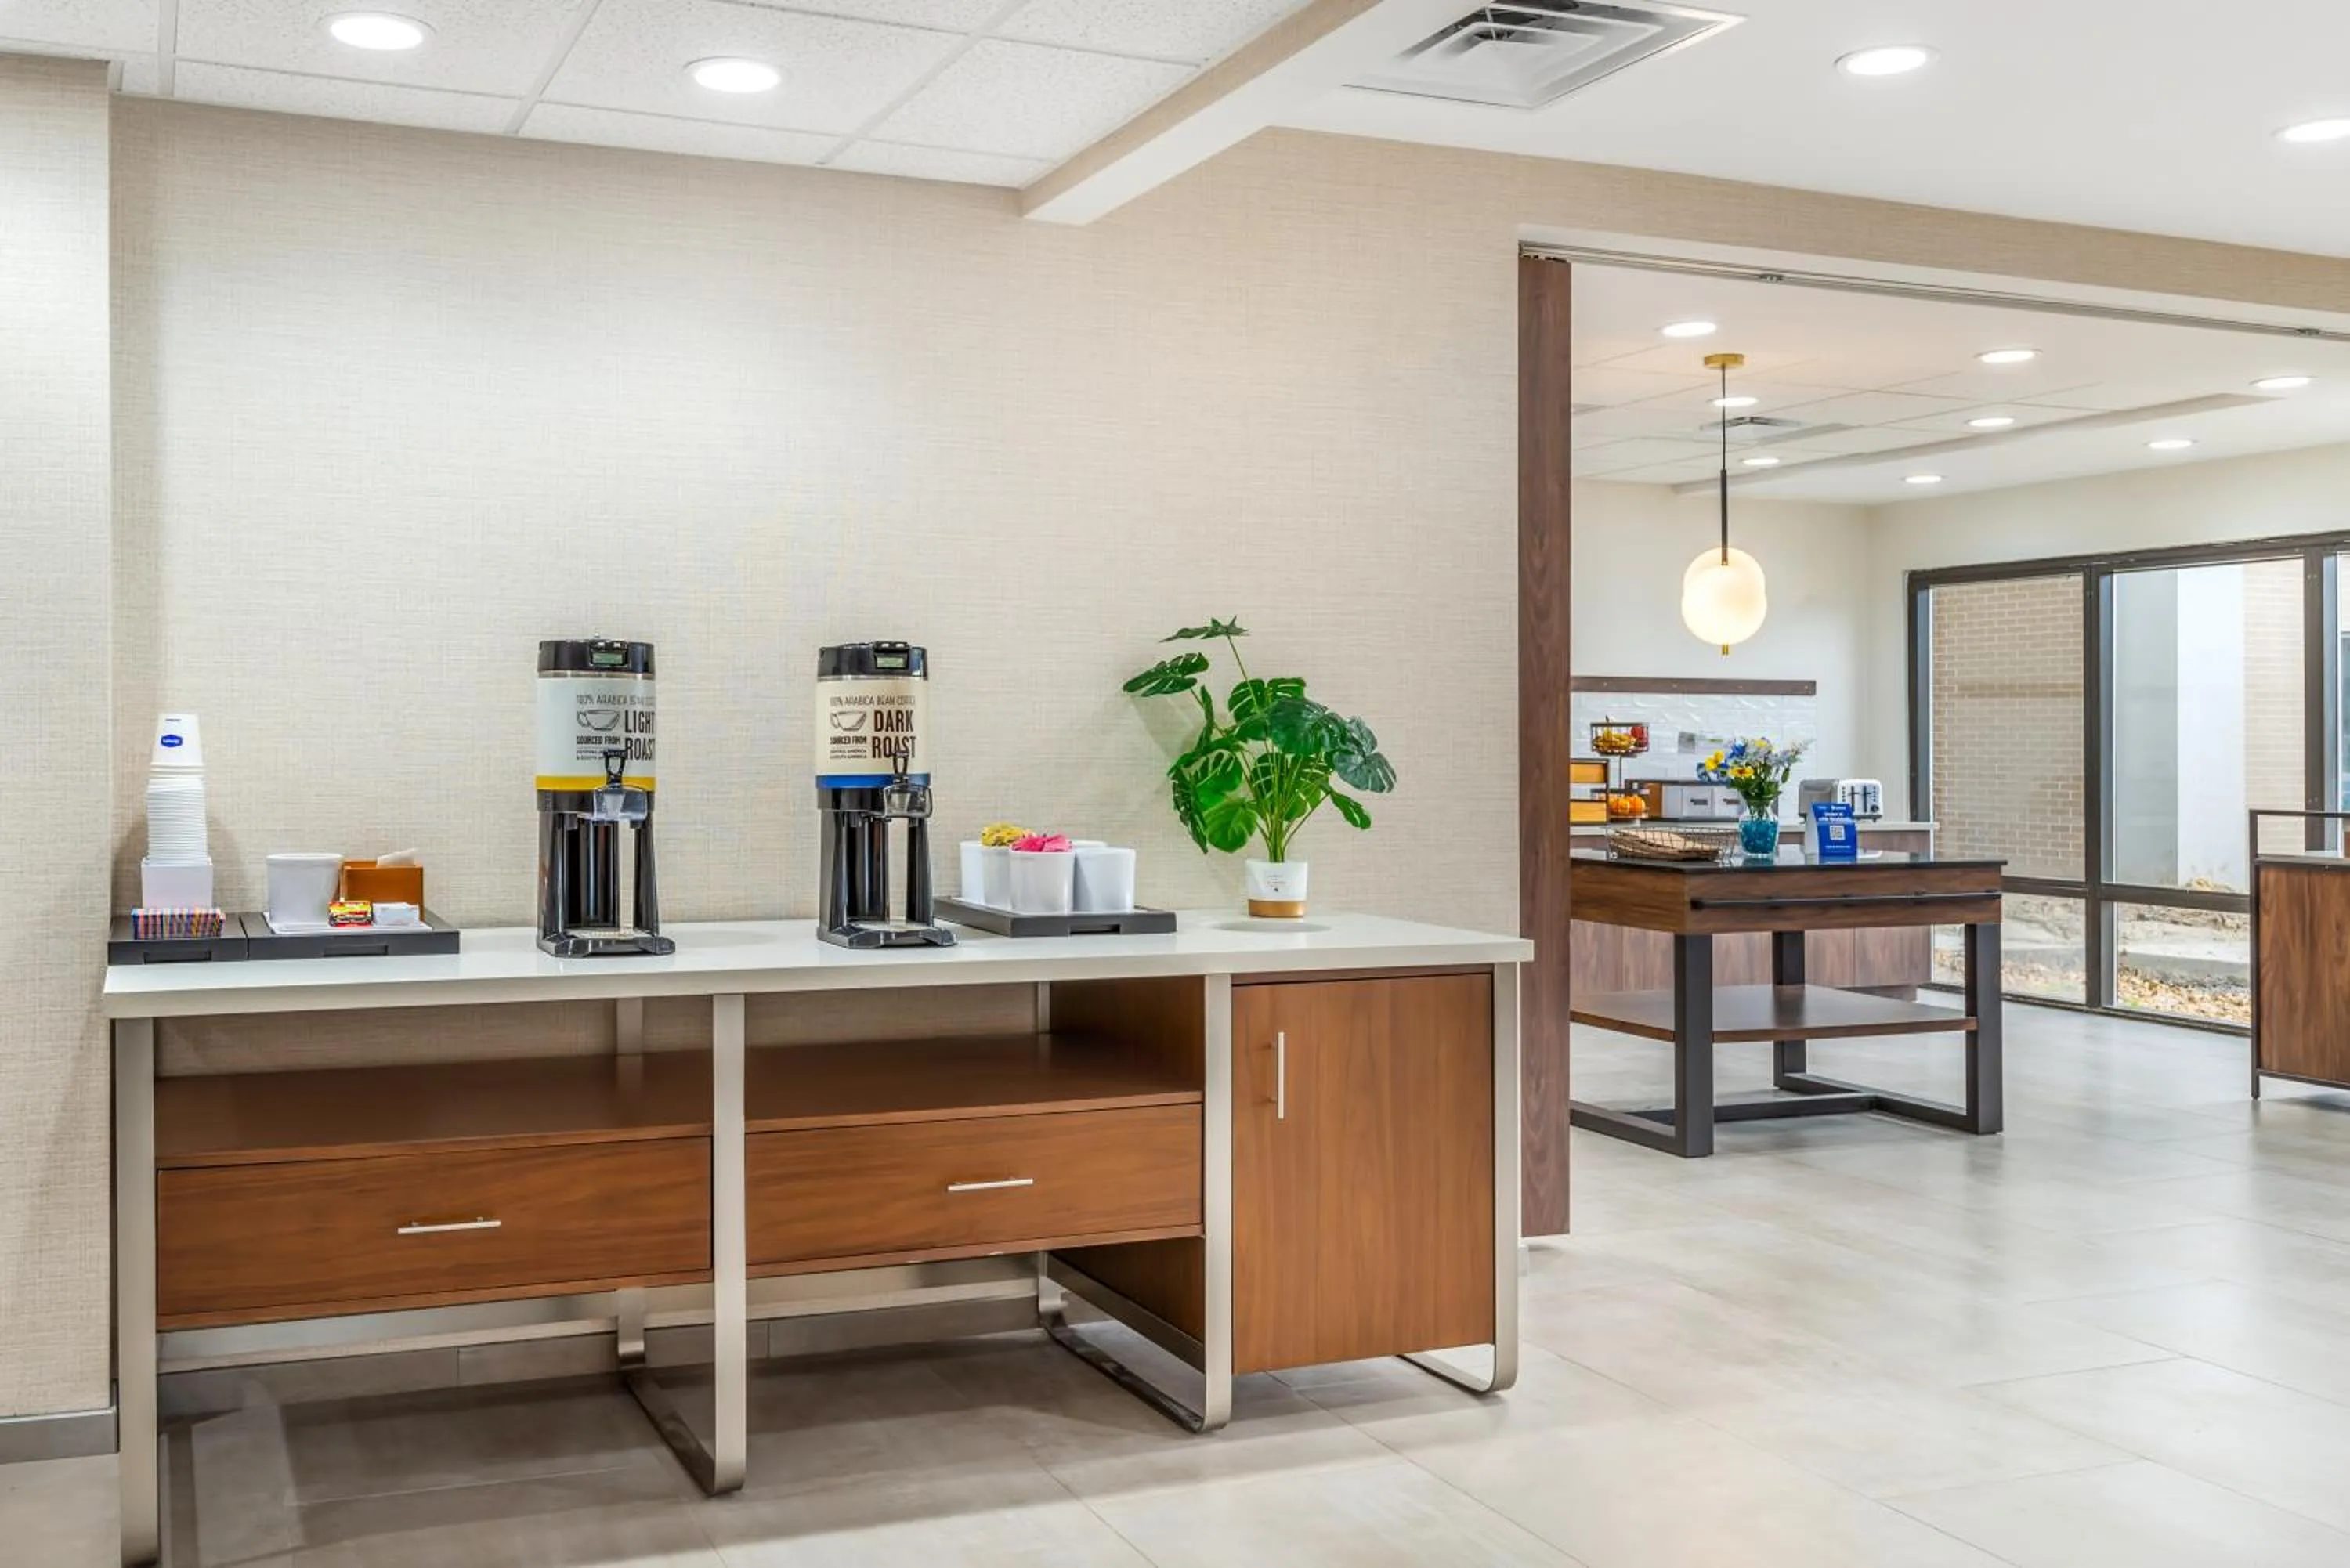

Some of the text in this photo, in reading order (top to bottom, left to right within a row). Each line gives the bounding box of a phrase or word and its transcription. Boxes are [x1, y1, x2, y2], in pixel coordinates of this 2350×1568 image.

[845, 695, 874, 706] ARABICA
[877, 695, 895, 706] BEAN
[624, 710, 655, 735] LIGHT
[873, 710, 914, 732] DARK
[604, 736, 621, 745] FROM
[851, 736, 867, 745] FROM
[871, 736, 917, 759] ROAST
